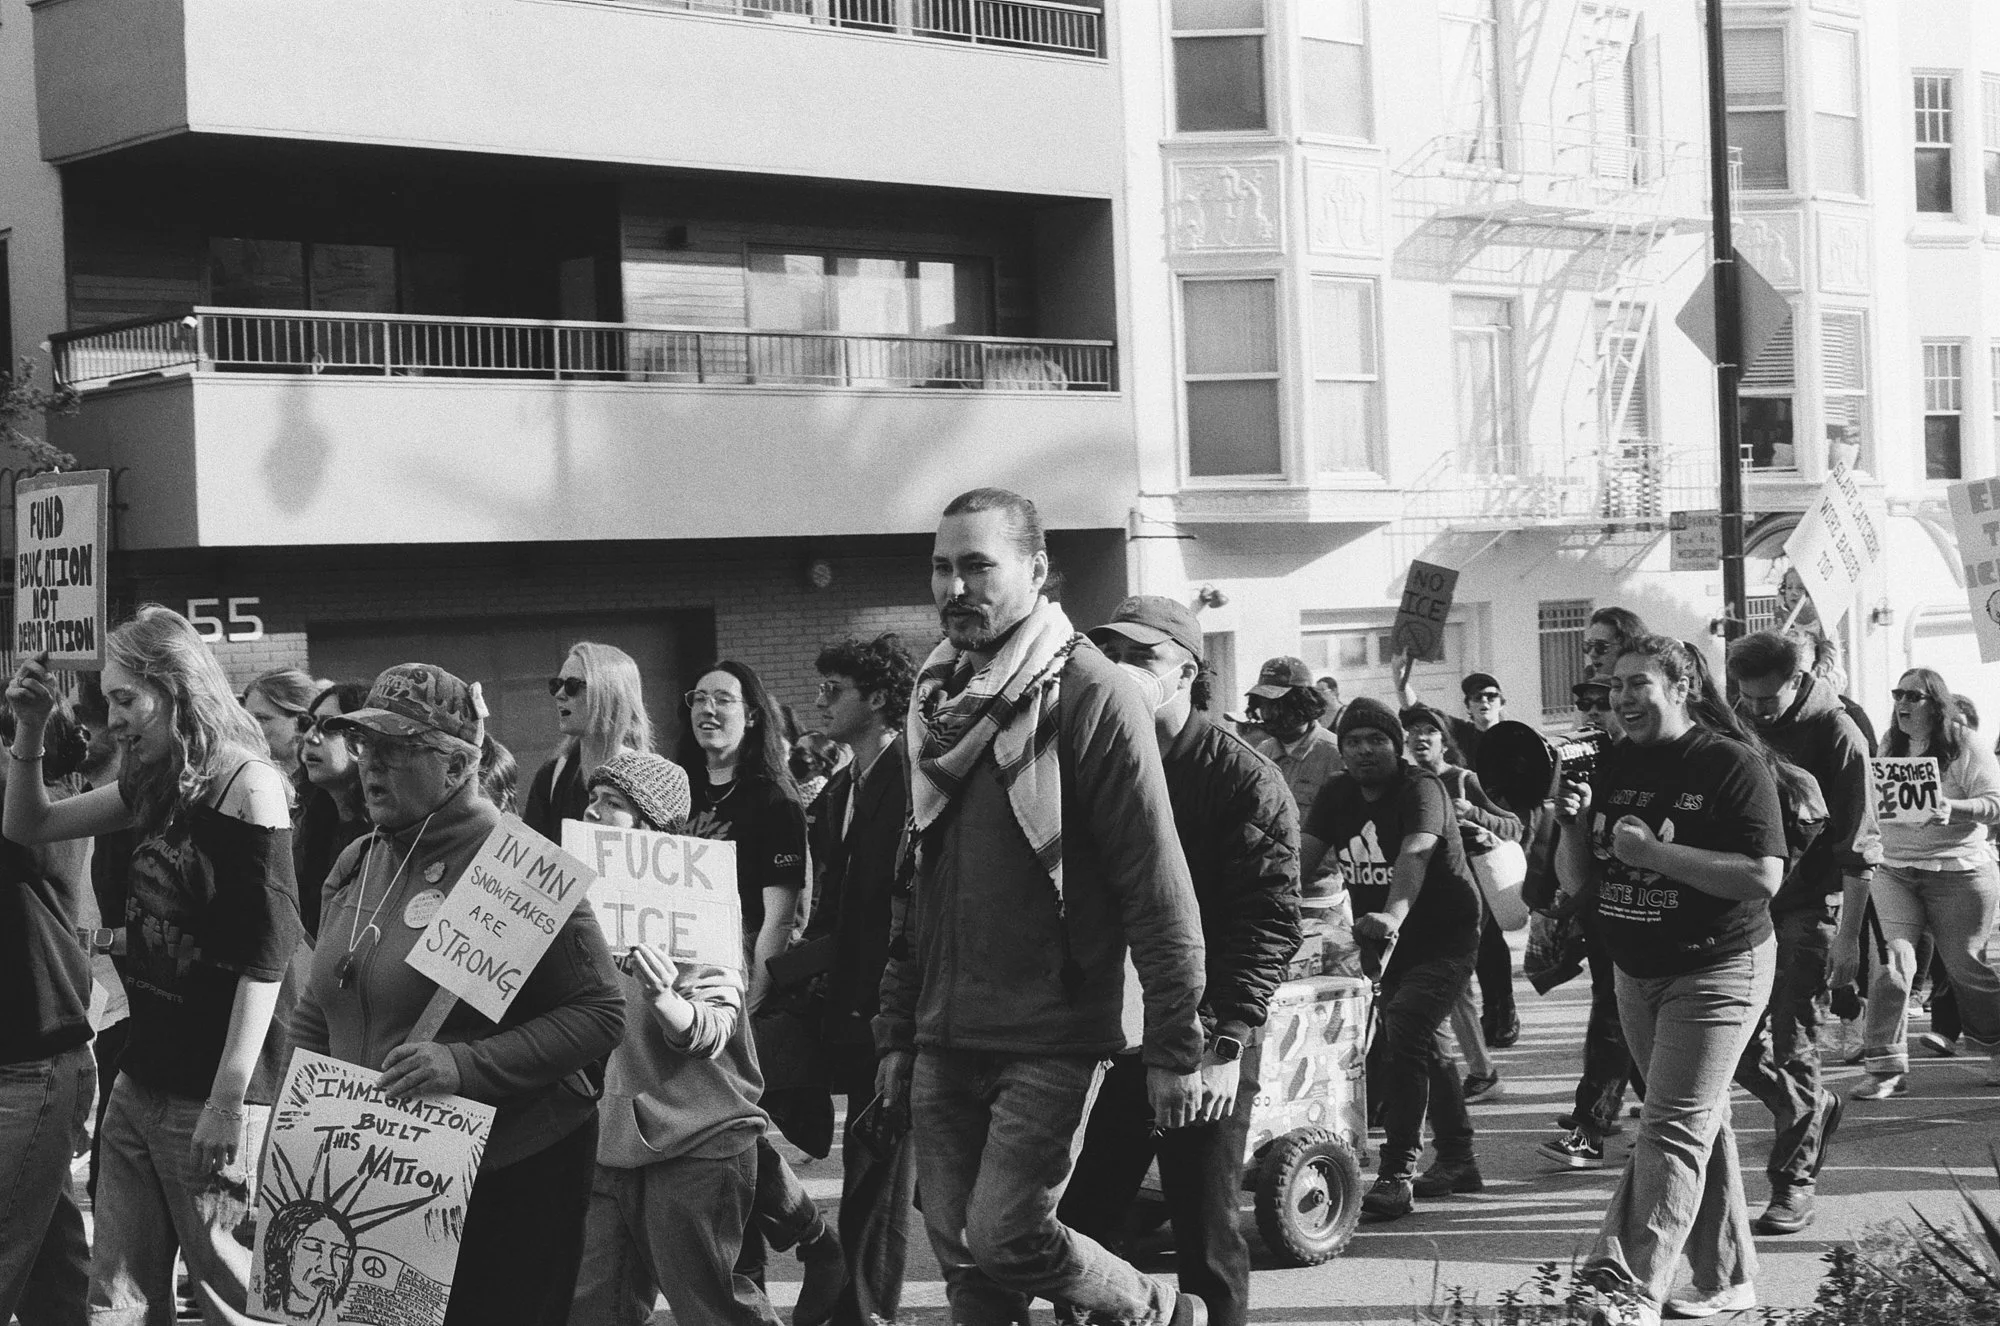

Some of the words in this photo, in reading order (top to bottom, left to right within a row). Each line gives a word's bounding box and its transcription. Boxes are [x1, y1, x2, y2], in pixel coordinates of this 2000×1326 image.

[30, 495, 64, 541] FUND
[19, 544, 93, 588] EDUCATION
[1414, 570, 1444, 592] NO
[33, 587, 58, 621] NOT
[1400, 590, 1446, 622] ICE
[18, 617, 95, 653] DEPORTATION
[1898, 781, 1938, 811] OUT
[495, 834, 529, 868] IN
[526, 855, 577, 902] MN
[594, 830, 713, 890] FUCK
[1337, 862, 1394, 885] didas
[470, 865, 555, 935] SNOWFLAKES
[1637, 888, 1679, 908] ICE
[469, 905, 507, 938] ARE
[603, 902, 698, 958] ICE
[427, 919, 521, 1000] STRONG
[315, 1079, 483, 1136] IMMIGRATION
[314, 1125, 360, 1153] THIS
[351, 1113, 431, 1142] BUILT
[406, 1268, 443, 1291] MEXICO
